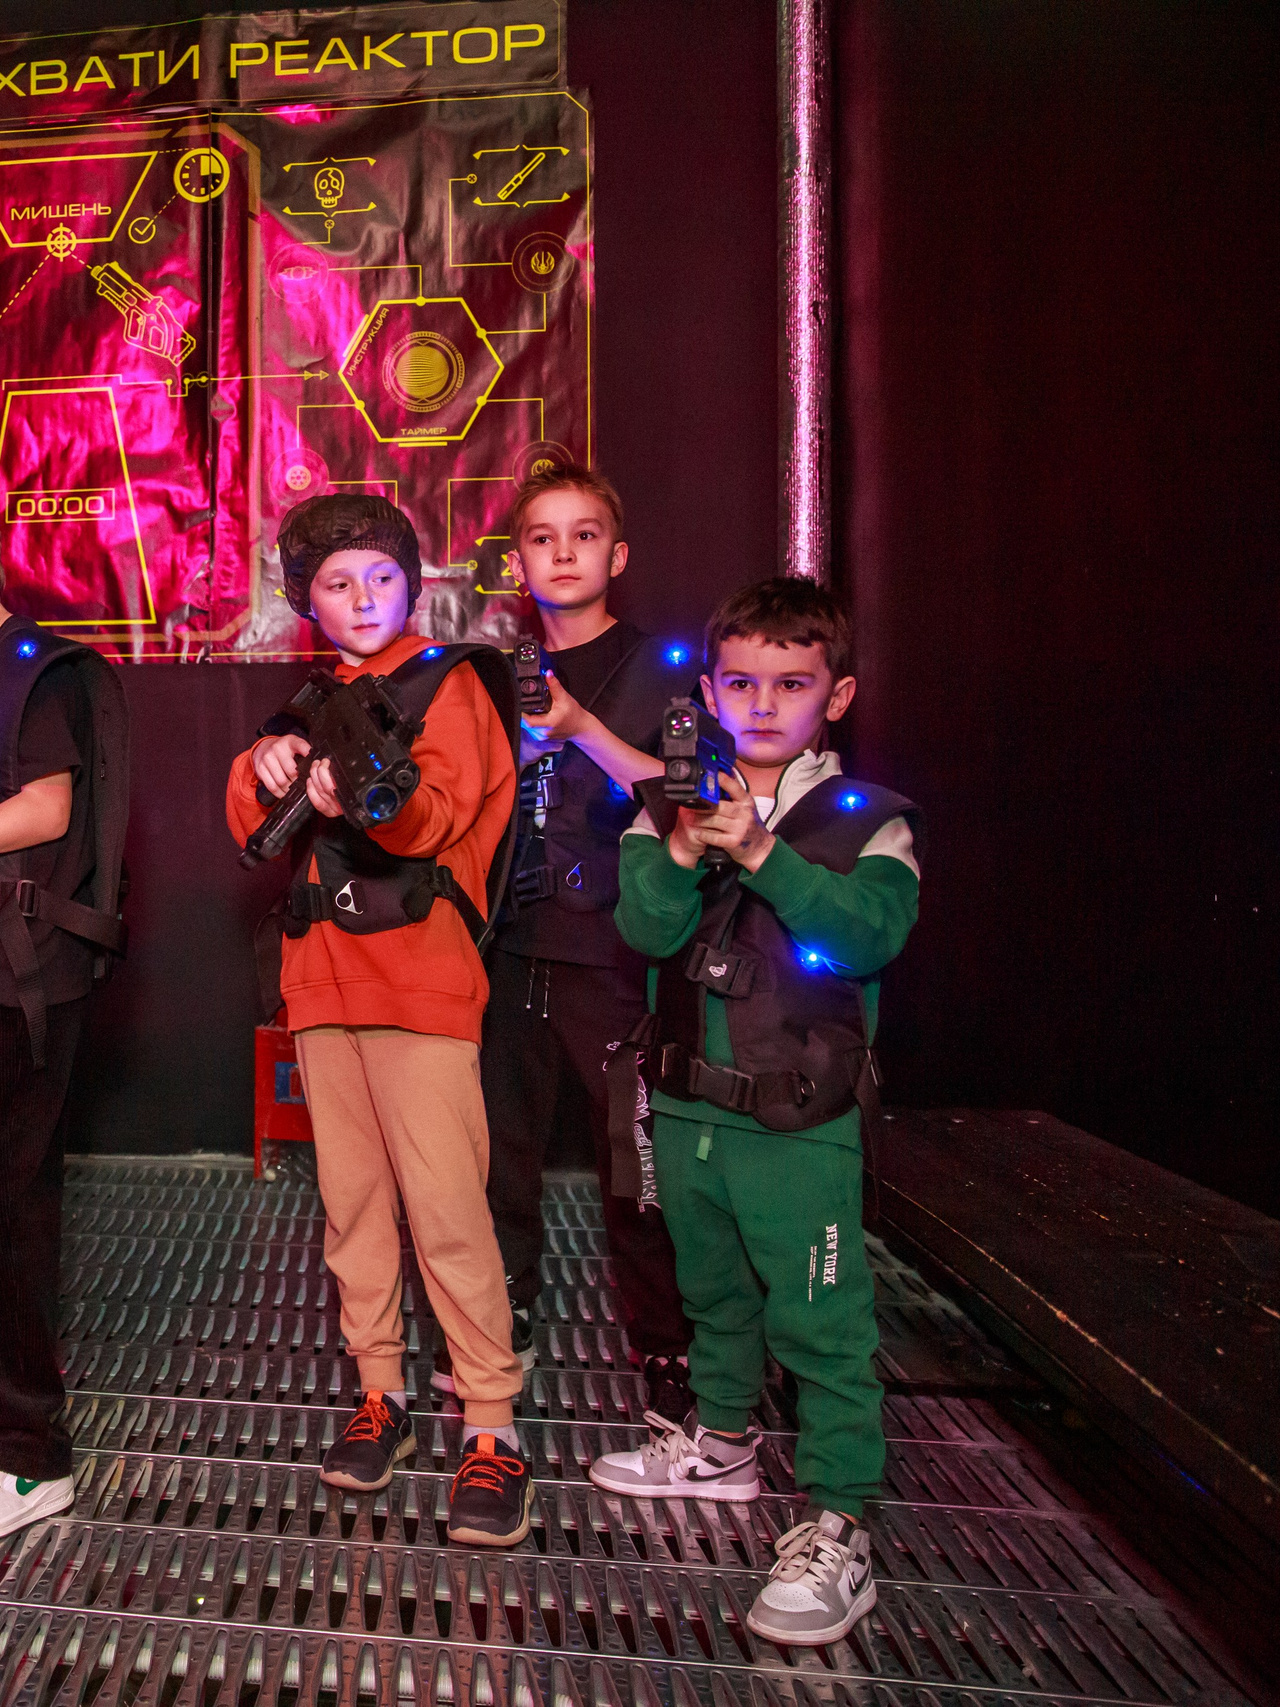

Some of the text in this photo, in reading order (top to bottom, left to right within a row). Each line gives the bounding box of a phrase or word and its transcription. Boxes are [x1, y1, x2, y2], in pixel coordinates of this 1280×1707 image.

[228, 24, 547, 79] РЕАКТОР
[11, 203, 112, 221] МИШЕНЬ
[347, 307, 390, 376] ИНСТРУКЦИЯ
[400, 426, 448, 436] ТАЙМЕР
[16, 496, 105, 517] 00:00
[823, 1223, 838, 1285] NEW YORK
